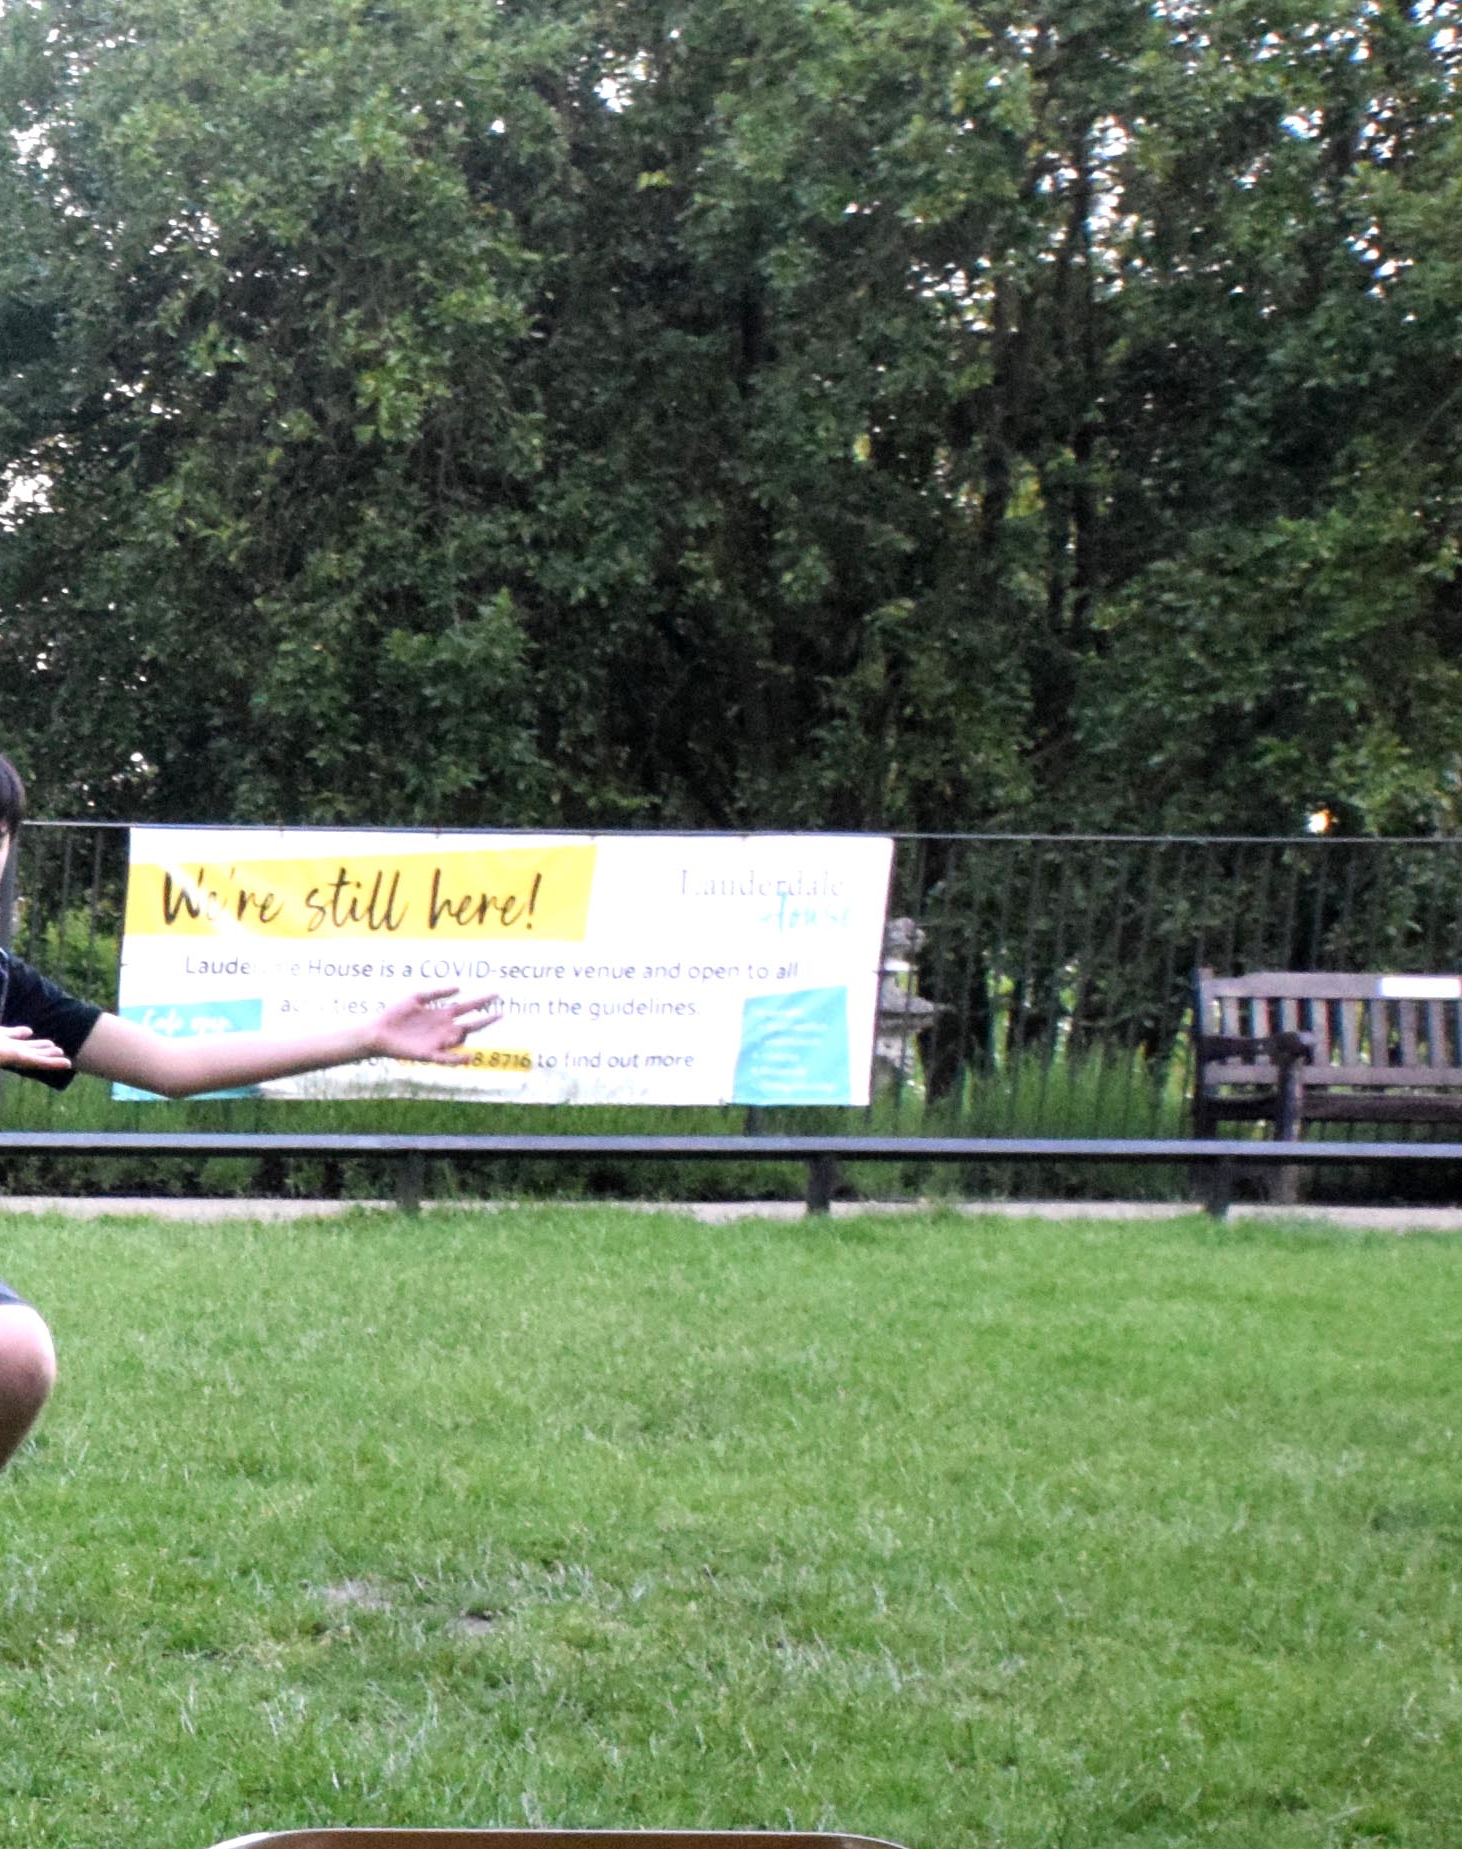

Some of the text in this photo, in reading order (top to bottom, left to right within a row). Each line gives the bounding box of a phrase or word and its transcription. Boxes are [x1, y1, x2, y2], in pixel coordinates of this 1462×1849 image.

[163, 865, 543, 933] We're still here!
[308, 959, 373, 978] House
[380, 959, 395, 978] is
[401, 963, 413, 978] a
[419, 960, 565, 979] COVID-secure
[573, 963, 636, 980] venue
[642, 961, 680, 980] and
[688, 962, 739, 984] open
[748, 962, 769, 980] to
[776, 961, 798, 980] all
[548, 998, 582, 1016] the
[538, 1053, 557, 1068] to
[564, 1051, 602, 1069] find
[607, 1053, 640, 1069] out
[644, 1054, 694, 1069] more
